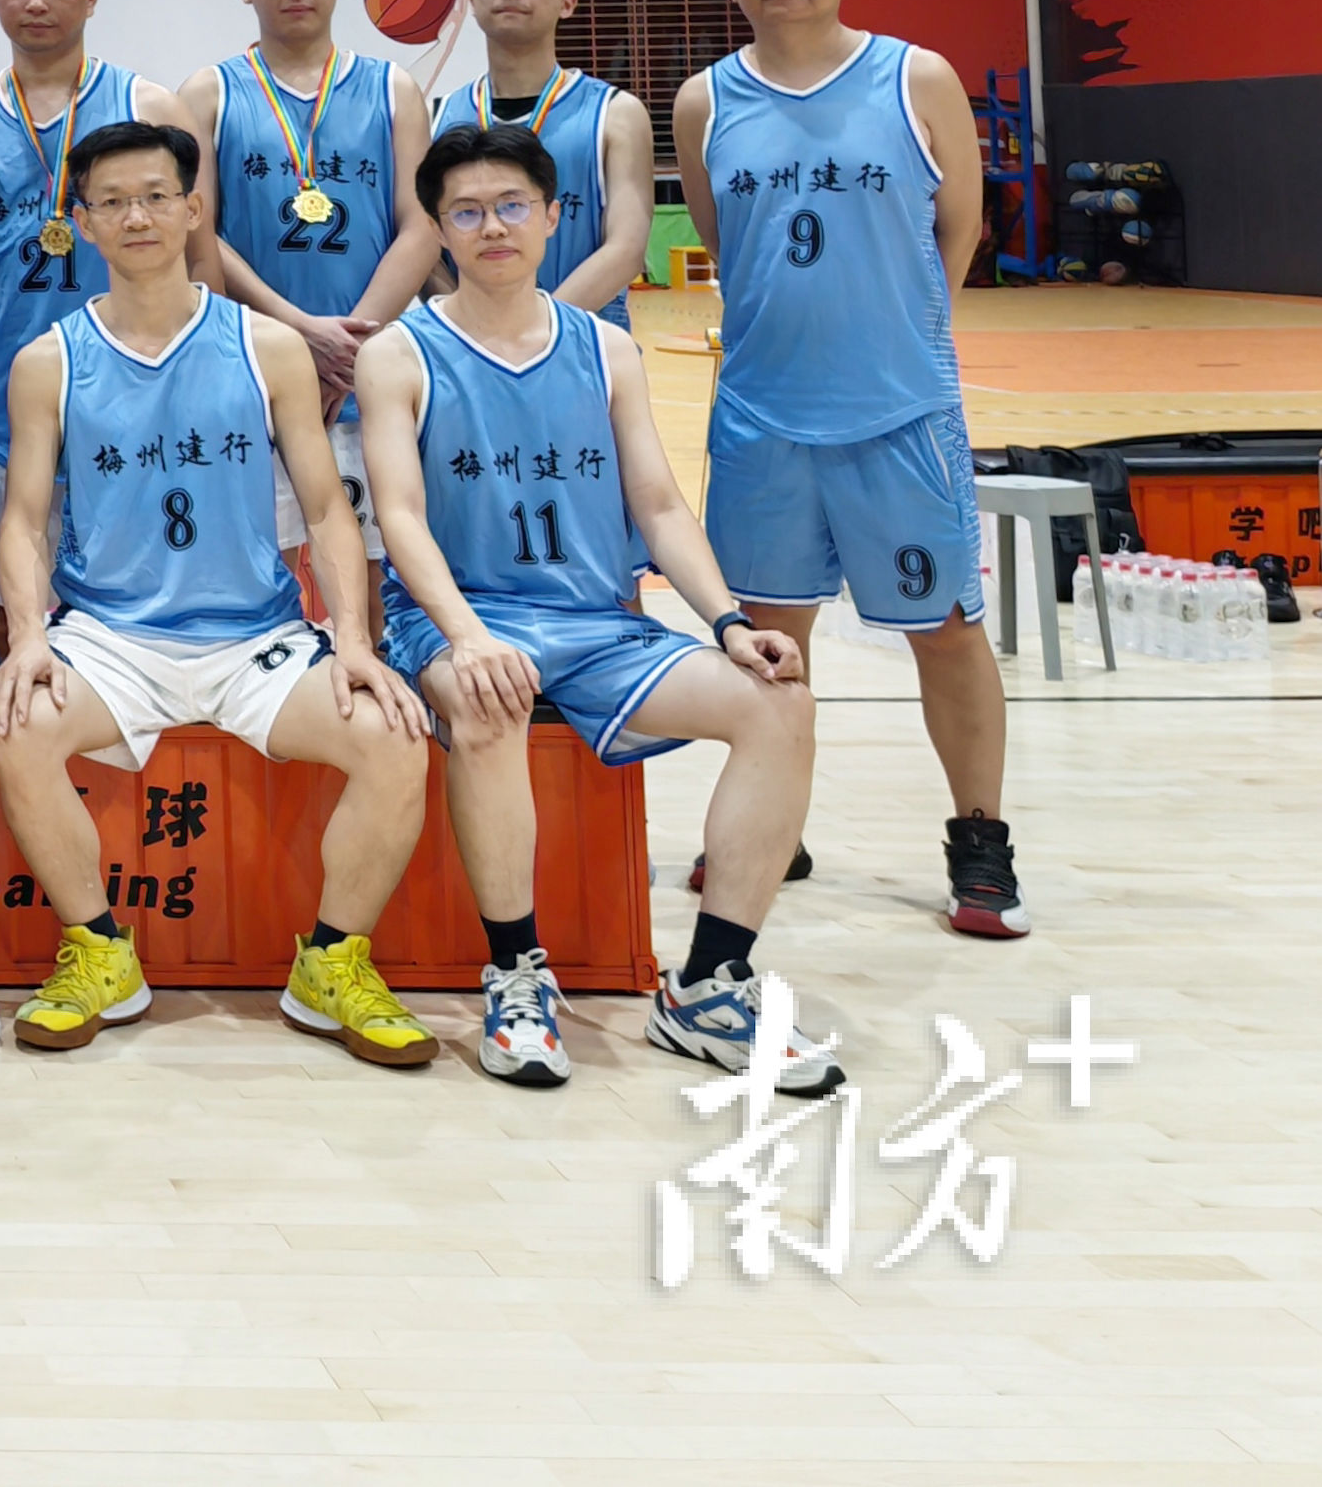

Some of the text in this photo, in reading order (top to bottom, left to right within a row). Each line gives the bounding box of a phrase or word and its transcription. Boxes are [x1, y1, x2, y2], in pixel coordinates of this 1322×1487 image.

[728, 156, 892, 199] 梅州建行
[277, 196, 350, 255] 22
[787, 209, 825, 268] 9
[93, 427, 253, 478] 梅州建行
[449, 442, 606, 484] 梅州建行
[161, 487, 198, 552] 8
[509, 499, 569, 565] 11
[894, 544, 937, 602] 9
